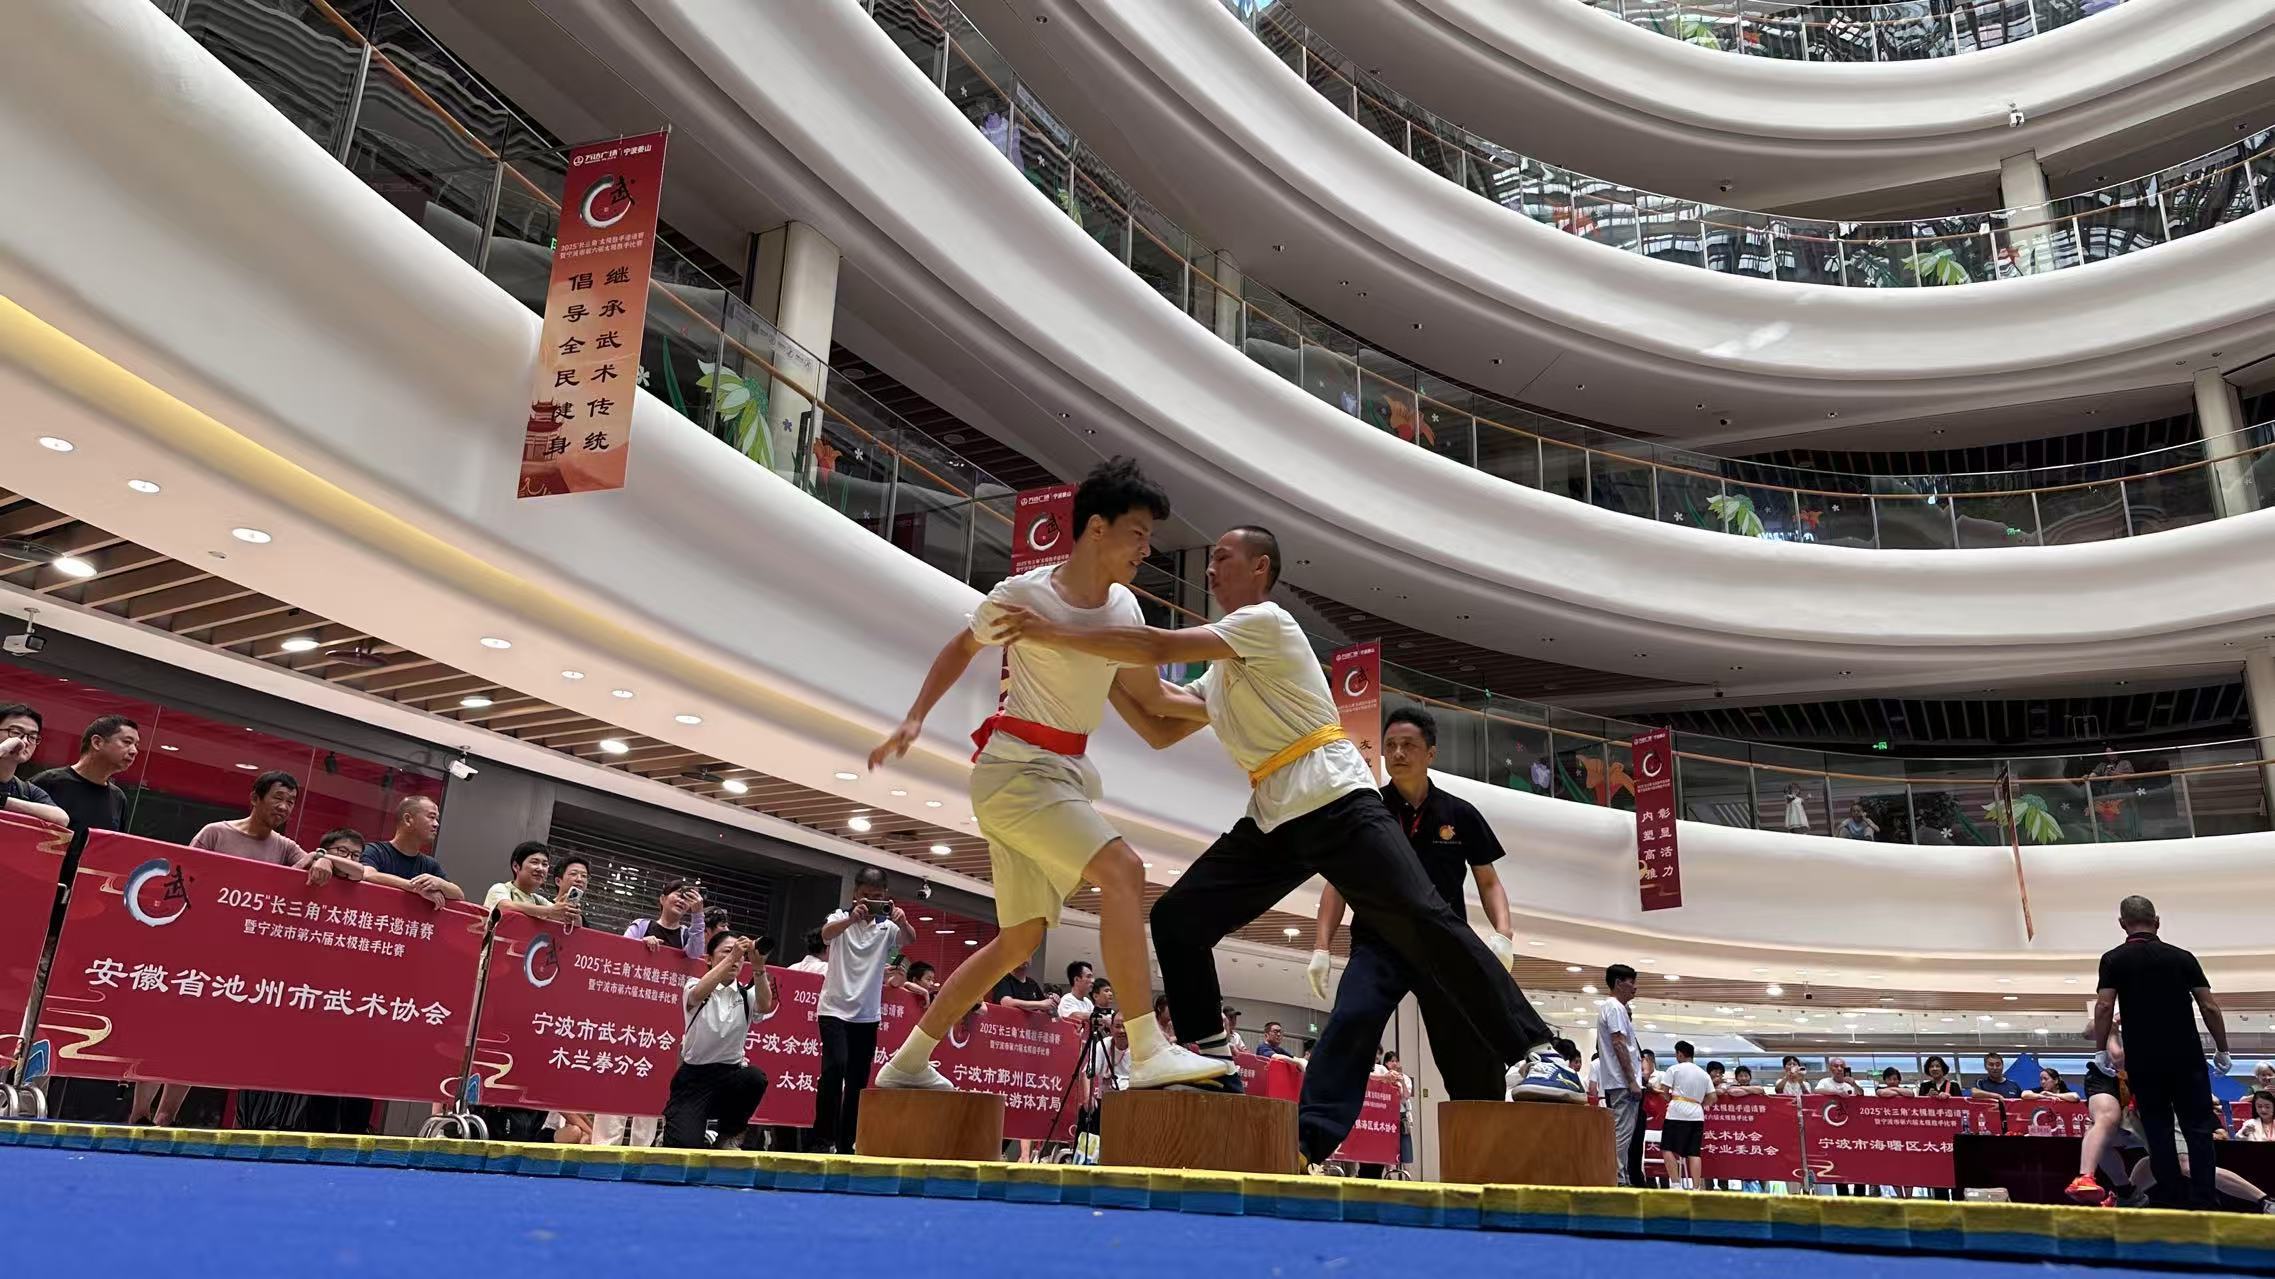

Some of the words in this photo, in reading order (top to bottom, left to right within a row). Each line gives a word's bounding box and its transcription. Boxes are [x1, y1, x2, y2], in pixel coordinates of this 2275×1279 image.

[544, 272, 594, 457] 倡导全民健身
[583, 266, 630, 451] 继承武术传统
[1641, 811, 1658, 880] 内塑高雅
[1658, 807, 1674, 878] 彰显活力
[243, 918, 406, 957] 暨宁波市第六届太极推手比赛
[85, 957, 452, 1025] 安徽省池州市武术协会
[532, 1012, 676, 1051] 宁波市武术协会
[744, 1031, 823, 1057] 宁波余姚
[549, 1046, 653, 1077] 木兰拳分会
[953, 1064, 1062, 1092] 宁波市鄞州区文化
[776, 1071, 818, 1092] 太极
[1700, 1143, 1780, 1156] 专业委员会
[1703, 1130, 1763, 1142] 武术协会
